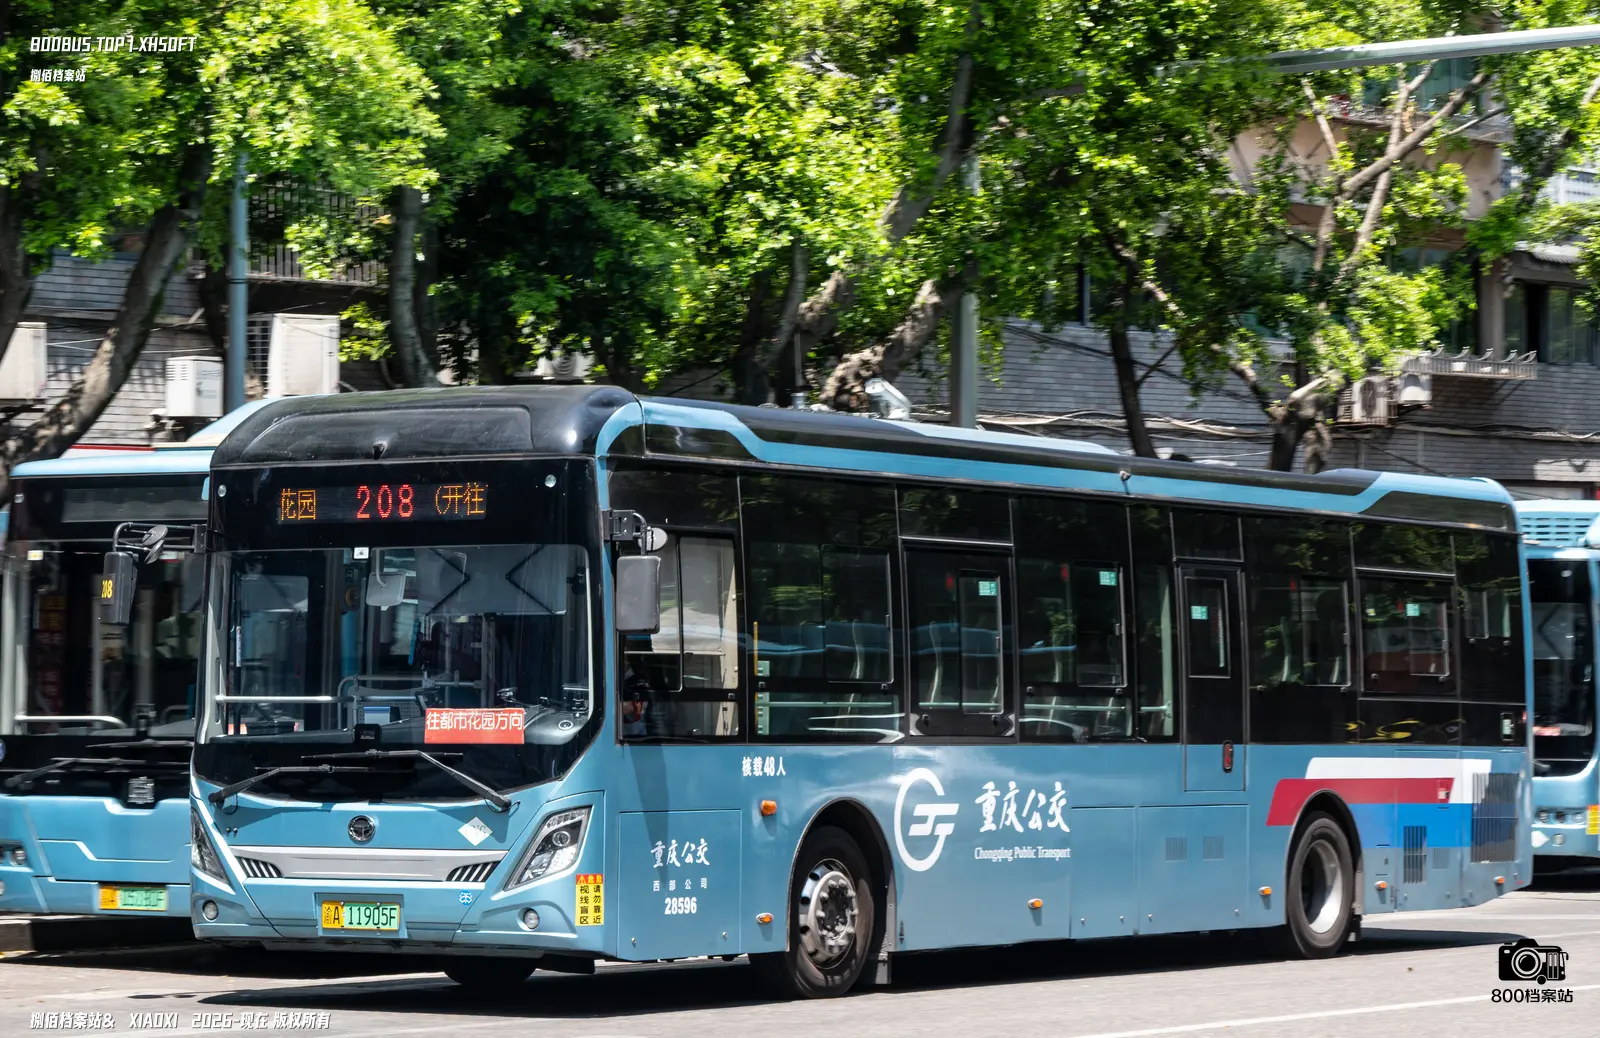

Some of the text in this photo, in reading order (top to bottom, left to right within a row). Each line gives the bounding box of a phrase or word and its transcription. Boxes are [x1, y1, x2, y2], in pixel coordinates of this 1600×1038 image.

[281, 488, 316, 520] 花园
[356, 484, 414, 519] 208
[425, 711, 523, 731] 往都市花园方向
[741, 756, 787, 777] 核载48人
[974, 780, 1071, 834] 重庆公交
[650, 838, 711, 868] 重庆公交
[974, 846, 1071, 862] Chongqing Public Transport
[664, 896, 698, 915] 28596
